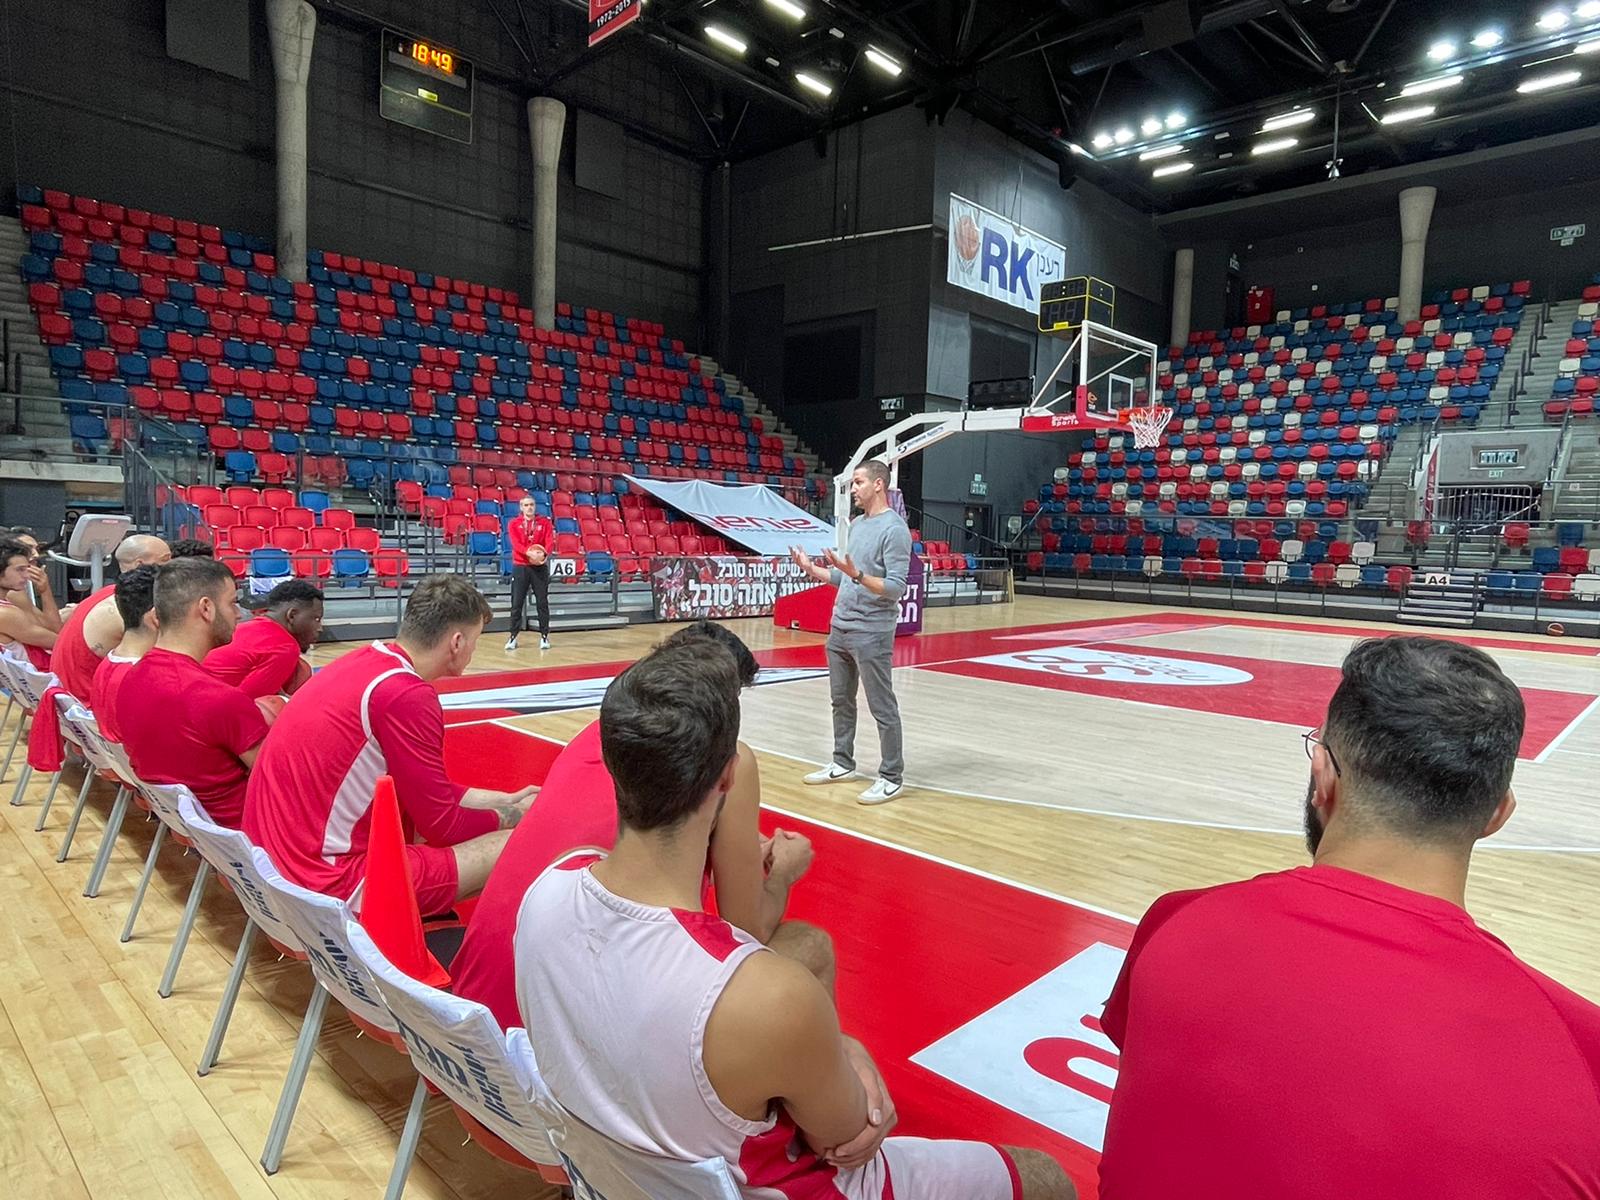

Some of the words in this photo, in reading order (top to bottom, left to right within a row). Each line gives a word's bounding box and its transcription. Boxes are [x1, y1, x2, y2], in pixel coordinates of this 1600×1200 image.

[980, 226, 1035, 301] RK
[1036, 252, 1060, 281] רענן
[1488, 469, 1504, 478] EXIT
[553, 562, 574, 576] A6
[748, 562, 774, 578] אתה
[1428, 575, 1448, 585] A4
[737, 582, 777, 606] אתה
